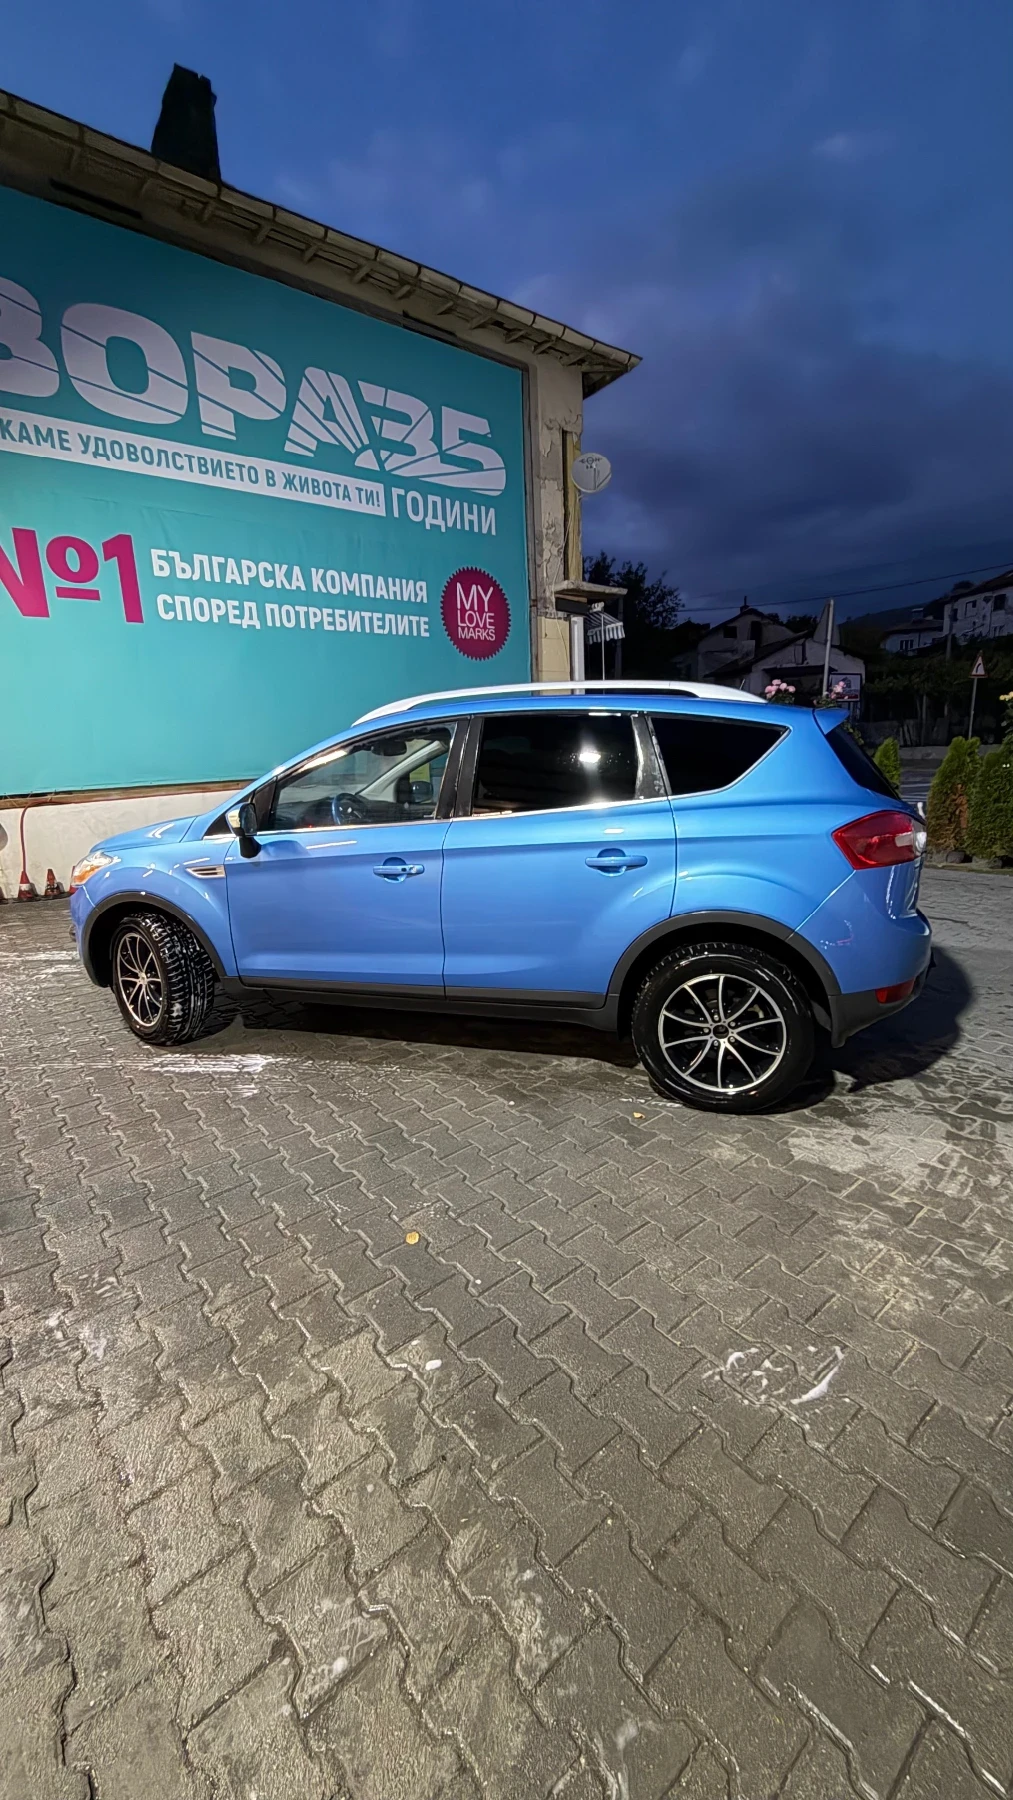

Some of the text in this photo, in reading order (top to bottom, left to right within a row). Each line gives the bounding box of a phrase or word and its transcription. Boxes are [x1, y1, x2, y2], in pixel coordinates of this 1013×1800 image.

[77, 432, 259, 485] УДОВОЛСТВИЕТО
[265, 468, 277, 488] В
[282, 473, 351, 501] ЖИВОТА
[355, 486, 380, 508] ТИ!
[391, 487, 496, 535] ГОДИНИ
[150, 548, 428, 603] БЪЛГАРСКА КОМПАНИЯ
[456, 582, 494, 612] MY
[156, 594, 430, 637] СПОРЕД ПОТРЕБИТЕЛИТЕ
[457, 609, 496, 629] LOVE
[458, 626, 496, 641] MARKS
